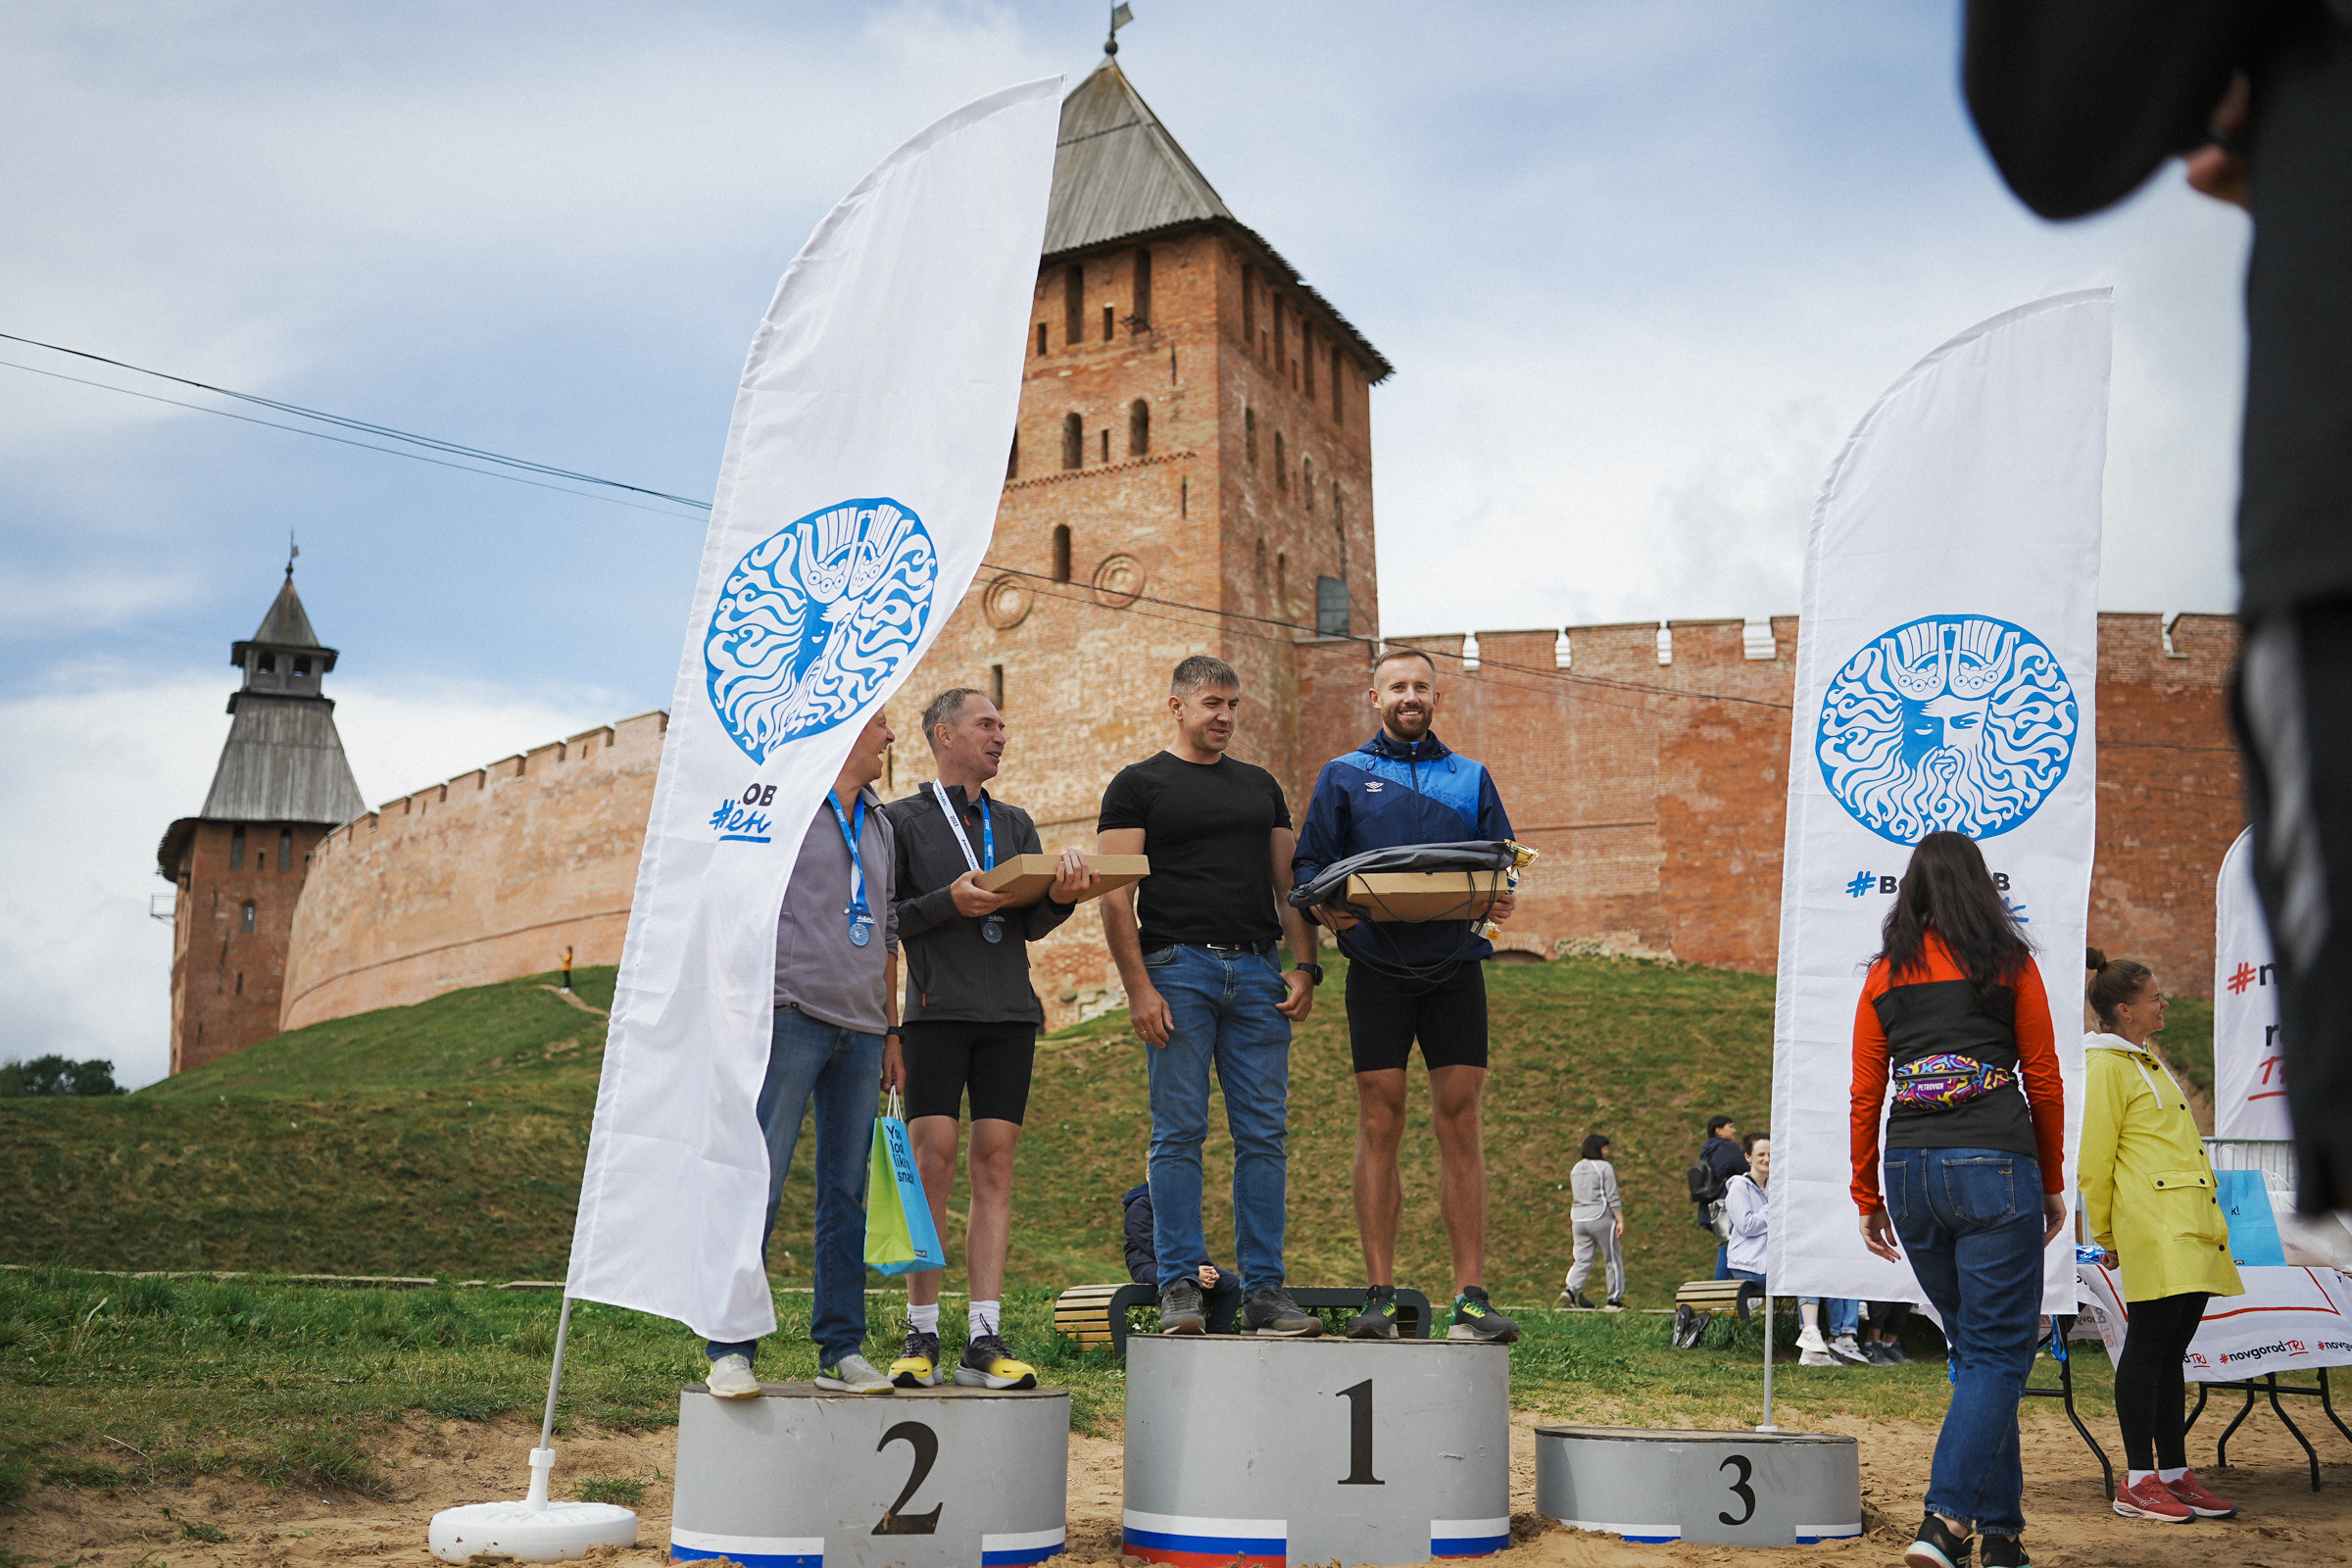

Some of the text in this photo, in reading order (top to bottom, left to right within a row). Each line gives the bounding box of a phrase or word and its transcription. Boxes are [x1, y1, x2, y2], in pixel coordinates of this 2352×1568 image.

[949, 815, 959, 827] 2023
[1917, 1082, 1944, 1092] PETROVICH
[1336, 1379, 1386, 1485] 1
[871, 1421, 944, 1536] 2
[1718, 1454, 1756, 1526] 3
